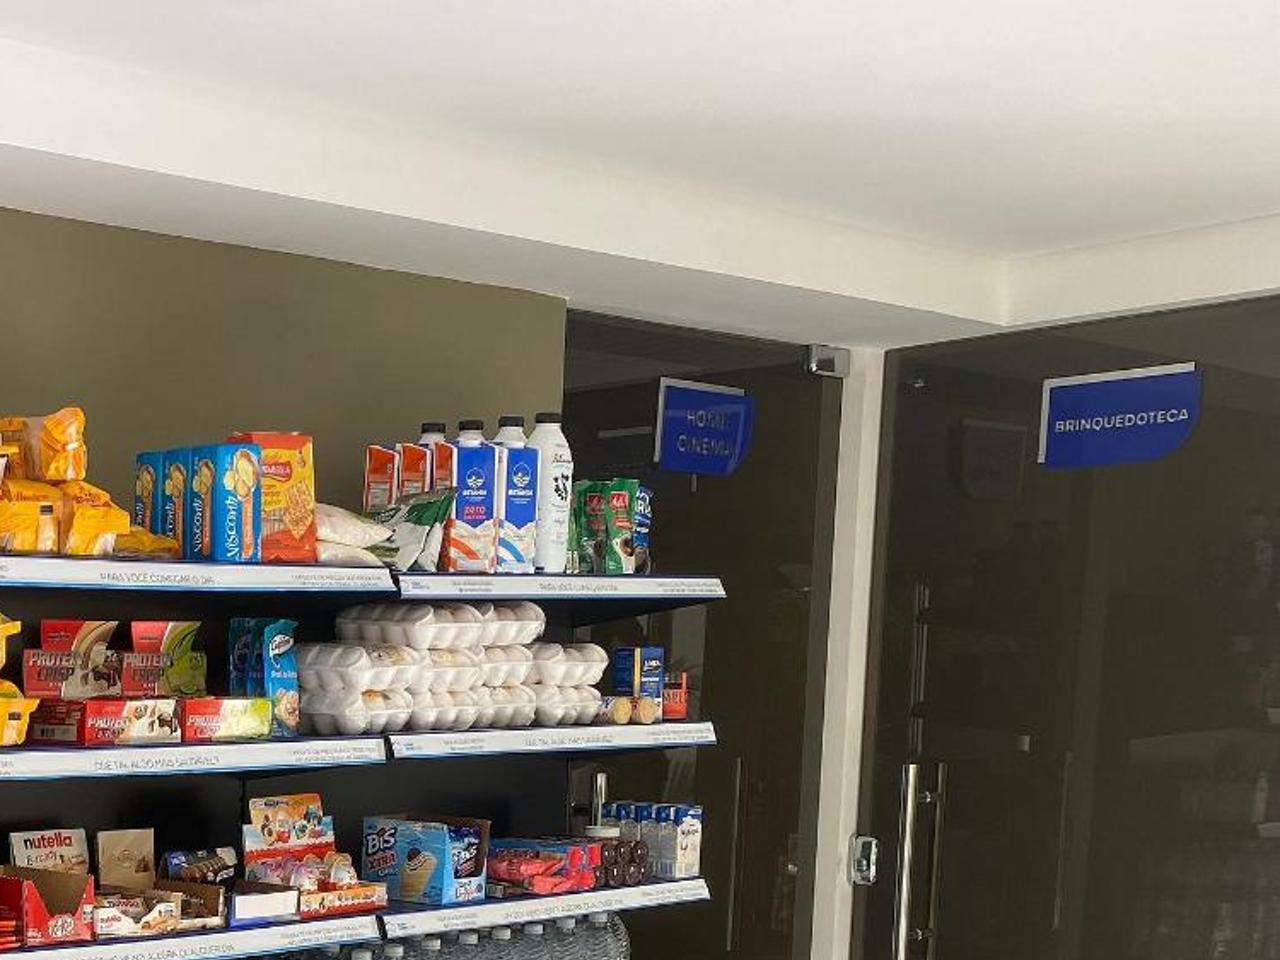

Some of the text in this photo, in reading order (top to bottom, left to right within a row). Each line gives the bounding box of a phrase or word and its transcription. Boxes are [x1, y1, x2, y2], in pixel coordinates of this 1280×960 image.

[1055, 408, 1188, 432] BRINQUEDOTECA
[29, 651, 82, 667] PROTEIN
[24, 832, 73, 850] nutella
